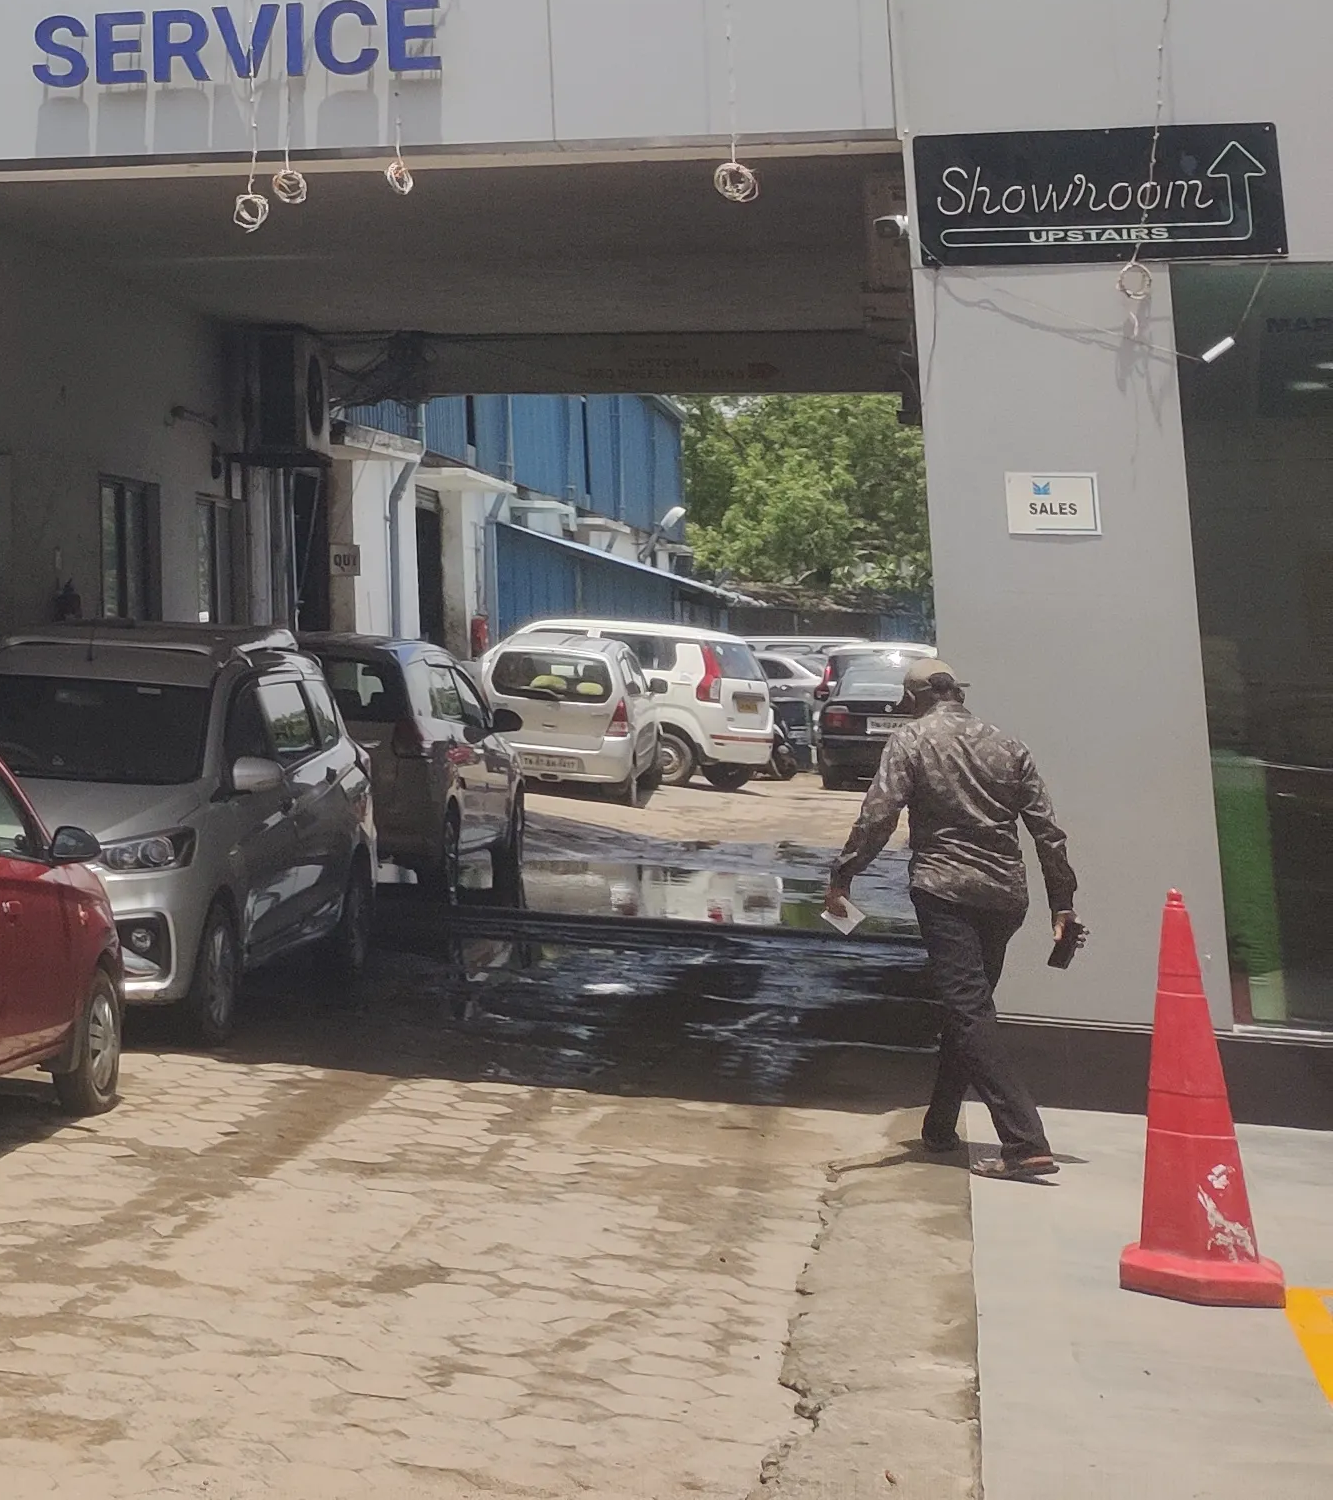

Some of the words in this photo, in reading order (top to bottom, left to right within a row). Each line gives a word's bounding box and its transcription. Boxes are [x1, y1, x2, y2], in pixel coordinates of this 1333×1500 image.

[937, 167, 1214, 216] Showroom
[1029, 226, 1169, 244] UPSTAIRS
[1028, 501, 1078, 517] SALES
